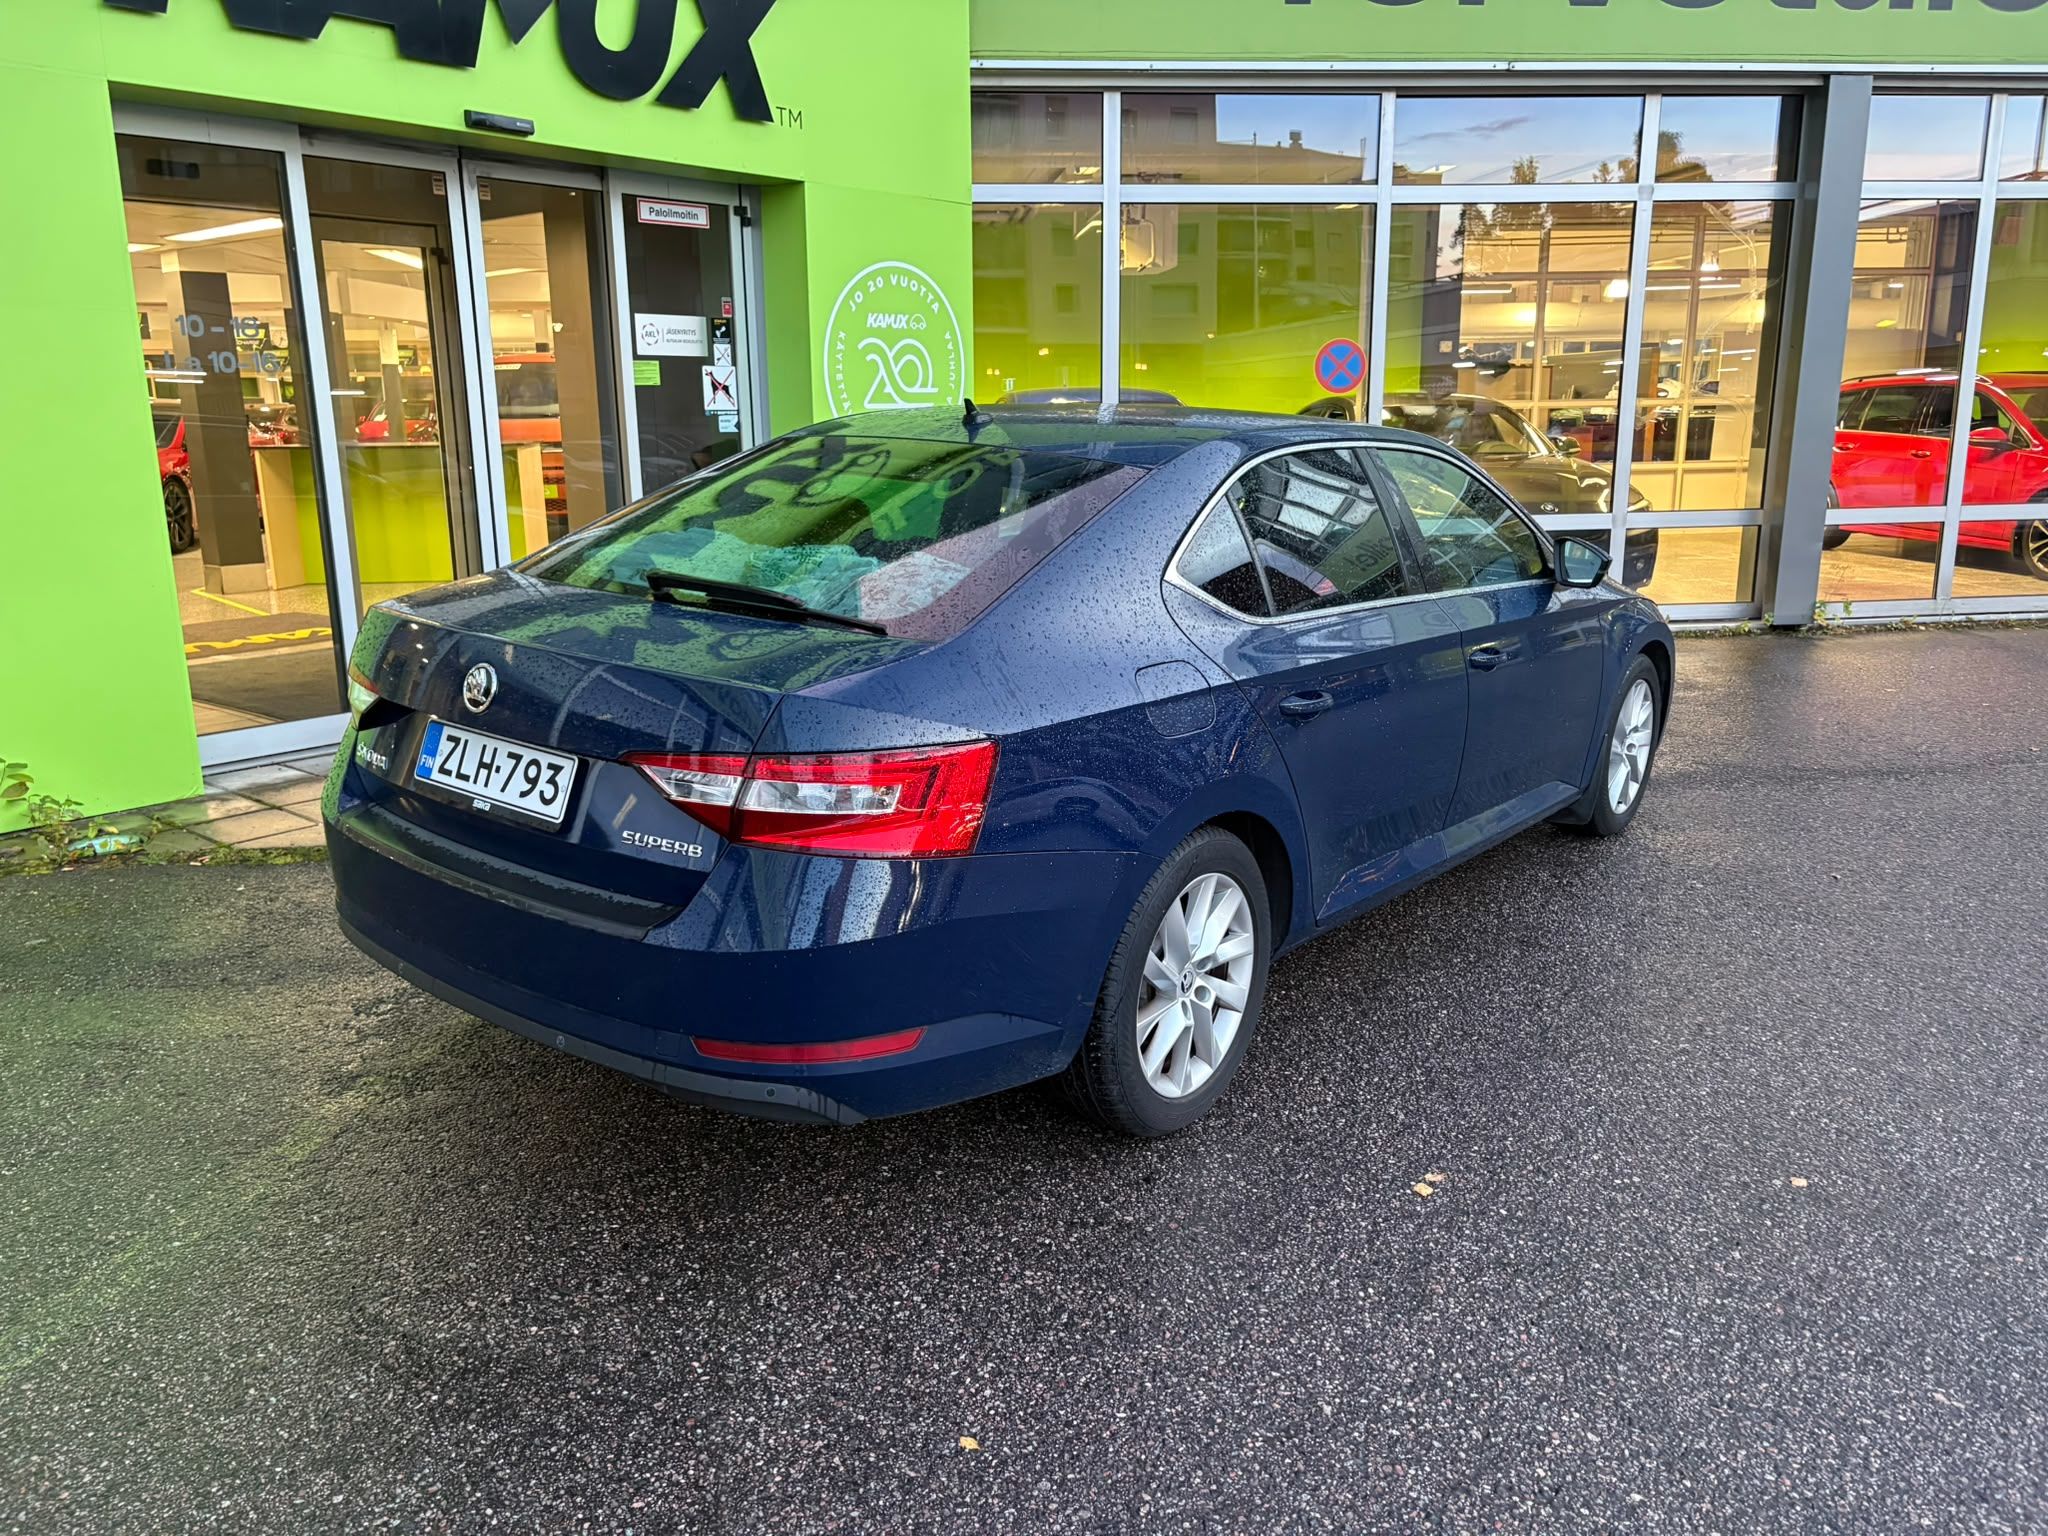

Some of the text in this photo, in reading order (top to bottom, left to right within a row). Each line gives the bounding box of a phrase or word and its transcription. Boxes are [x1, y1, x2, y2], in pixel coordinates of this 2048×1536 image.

[776, 106, 803, 129] TM
[648, 206, 699, 221] Paloilmoitin
[849, 273, 940, 315] JO 20 VUOTTA
[175, 314, 205, 338] 10
[866, 312, 909, 329] KAMUX
[420, 754, 436, 769] FIN
[437, 733, 565, 807] ZLH-793
[621, 830, 703, 858] SUPERB
